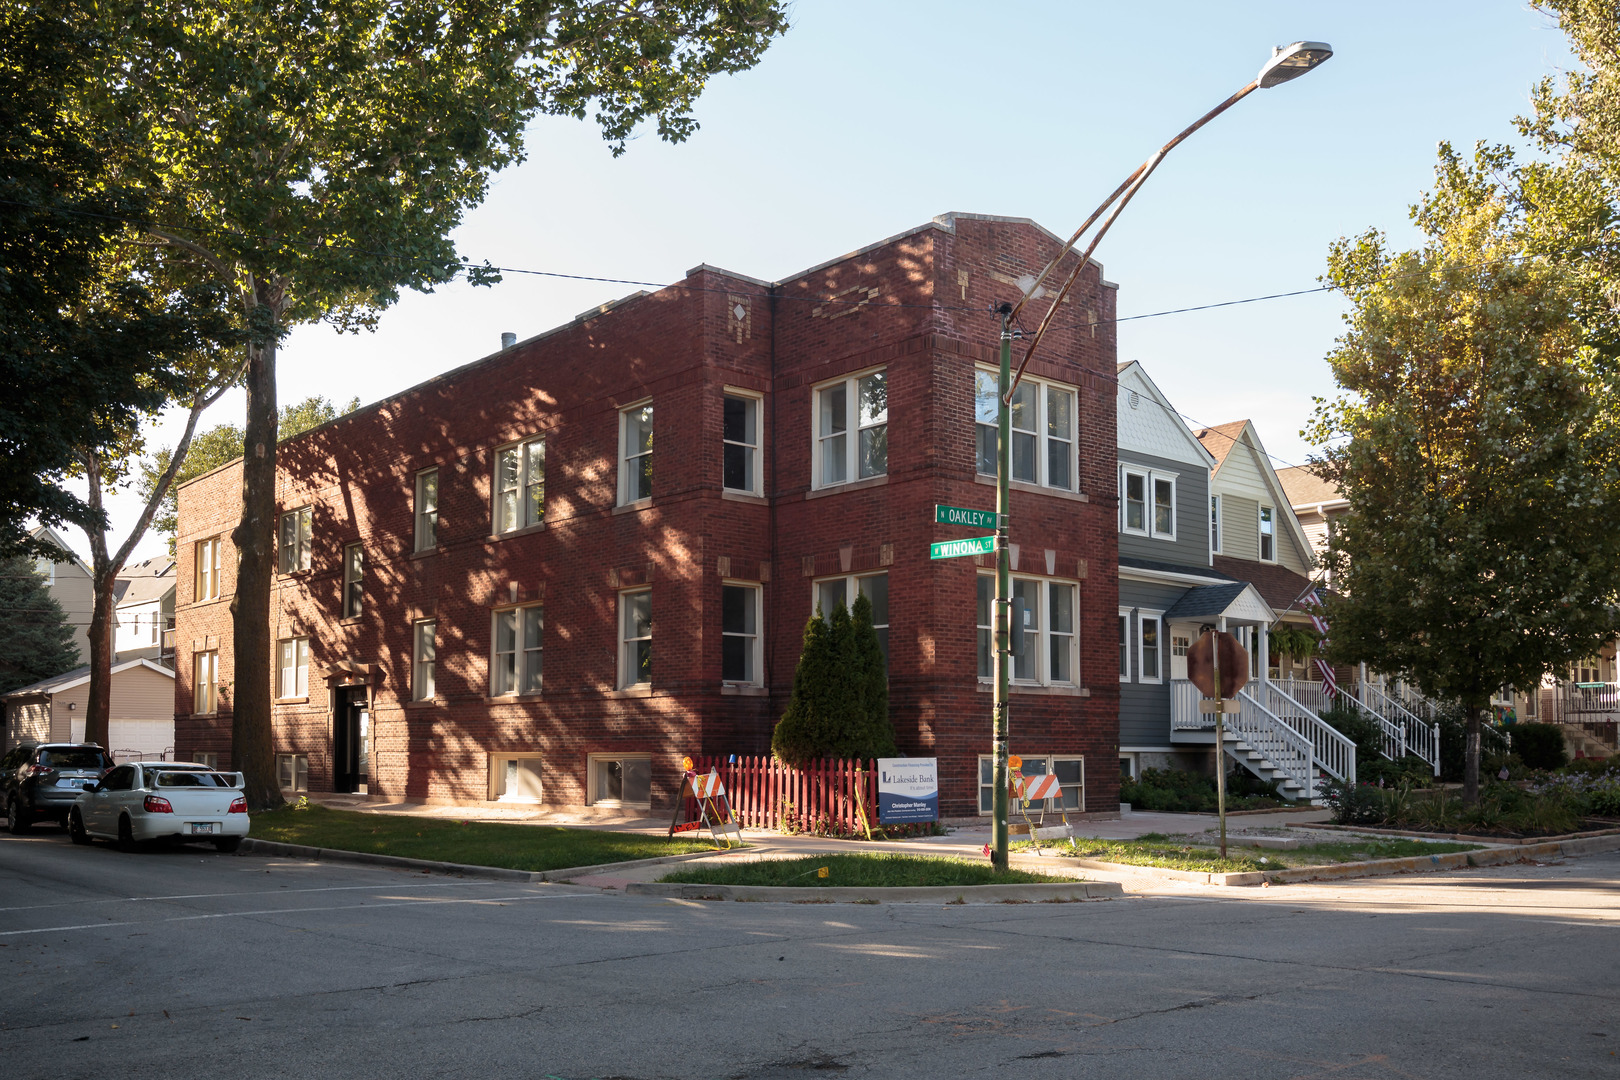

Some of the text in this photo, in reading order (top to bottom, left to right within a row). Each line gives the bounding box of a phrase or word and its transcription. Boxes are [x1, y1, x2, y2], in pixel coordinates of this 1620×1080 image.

[949, 509, 984, 525] OAKLEY
[940, 540, 983, 556] WINONA
[985, 540, 991, 548] ST
[893, 774, 934, 783] Lakeside Bank
